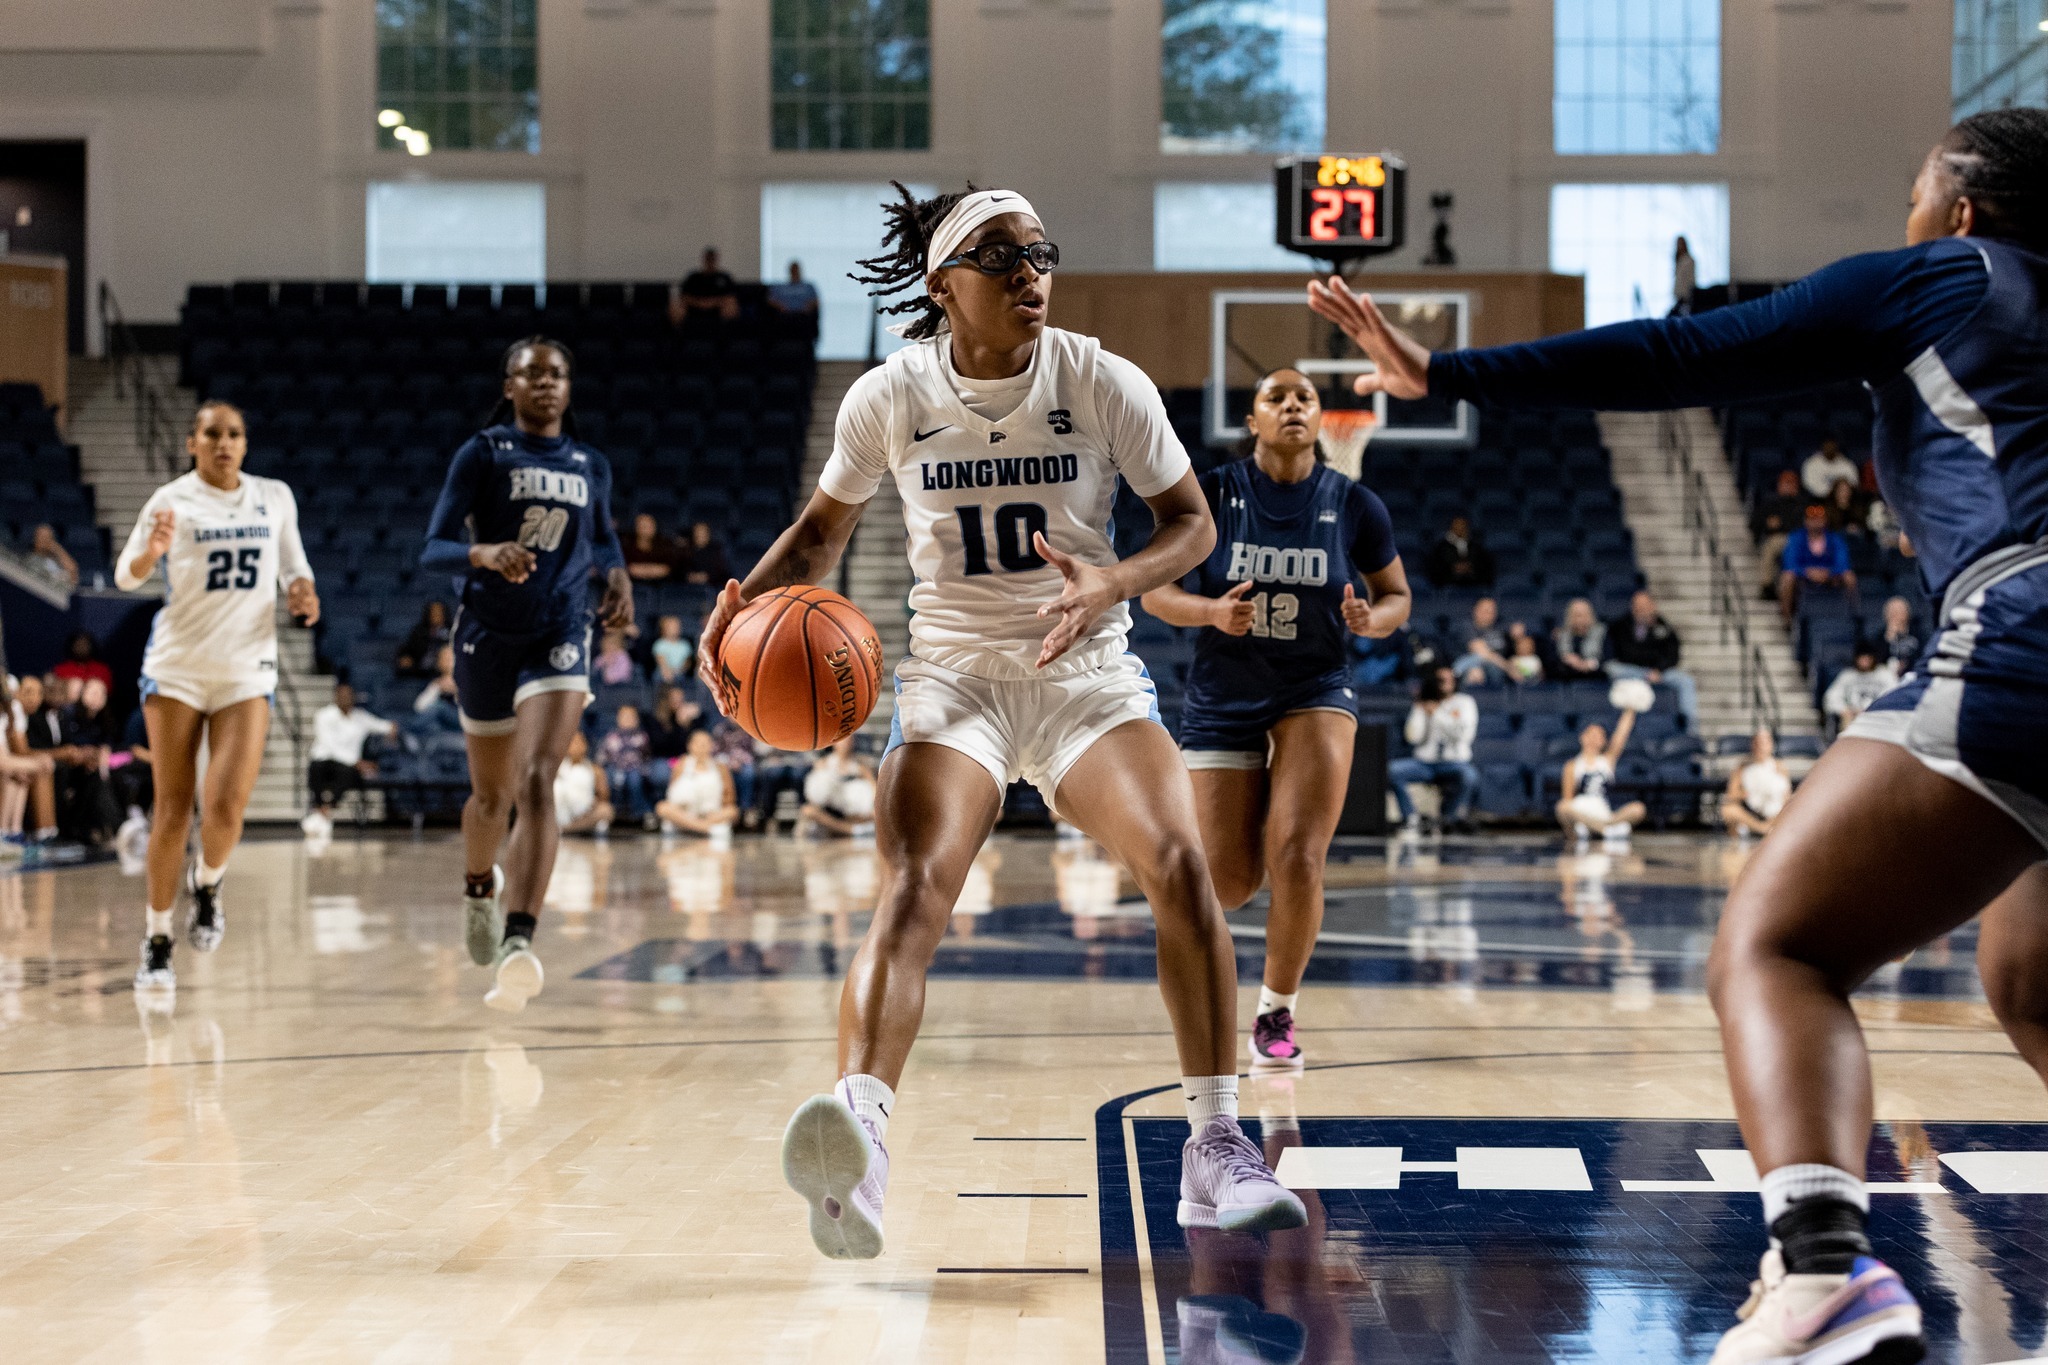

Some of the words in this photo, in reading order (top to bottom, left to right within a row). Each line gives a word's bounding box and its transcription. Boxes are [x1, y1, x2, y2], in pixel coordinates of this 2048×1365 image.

[1317, 156, 1386, 187] 2:46
[1310, 188, 1375, 241] 27
[509, 467, 589, 508] HOOD
[921, 454, 1078, 490] LONGWOOD
[517, 505, 570, 552] 20
[954, 502, 1049, 577] 10
[206, 548, 262, 592] 25
[1226, 542, 1328, 587] HOOD
[1250, 592, 1299, 641] 12
